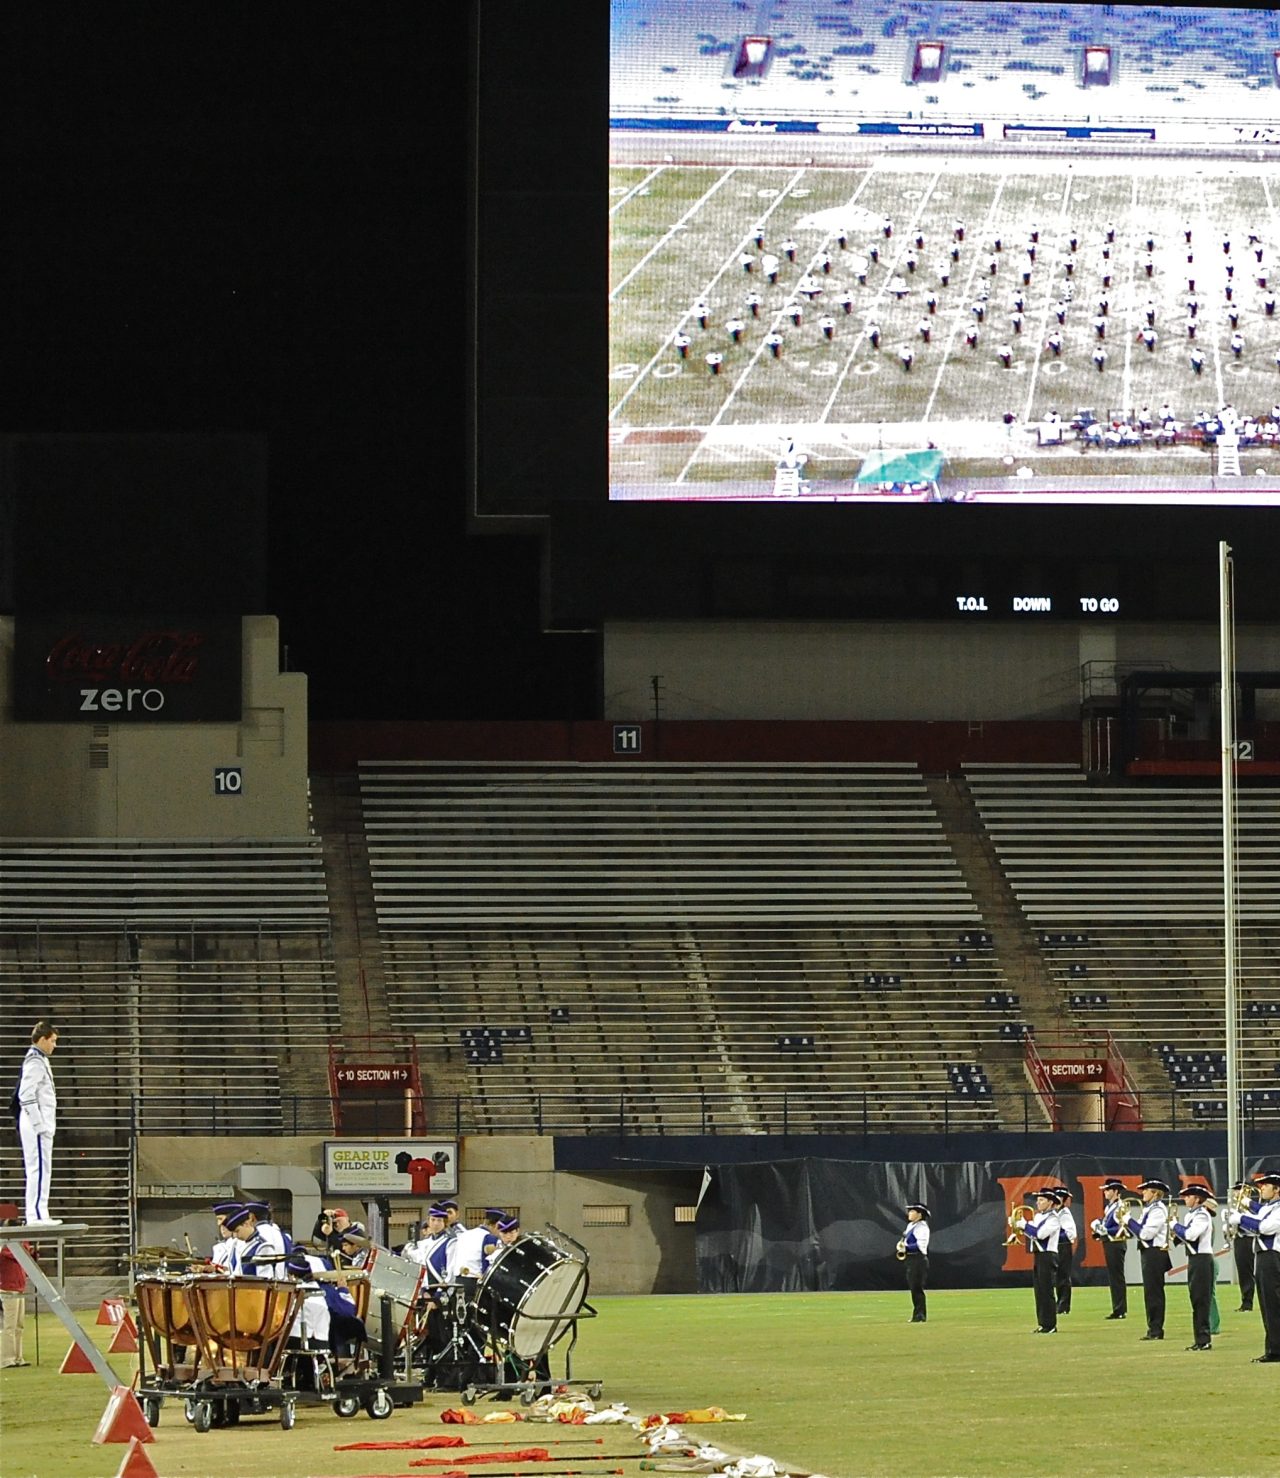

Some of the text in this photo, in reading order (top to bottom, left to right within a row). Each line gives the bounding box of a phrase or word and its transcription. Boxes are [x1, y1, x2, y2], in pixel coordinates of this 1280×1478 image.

[1013, 597, 1051, 611] DOWN
[1080, 598, 1119, 612] TO GO
[79, 688, 165, 711] zero
[618, 730, 637, 749] 11
[215, 771, 241, 791] 10
[345, 1070, 400, 1081] 10 SECTION 11
[1052, 1064, 1084, 1076] SECTION
[1086, 1064, 1095, 1075] 12
[333, 1150, 390, 1161] GEAR UP
[333, 1162, 389, 1171] WILDCATS
